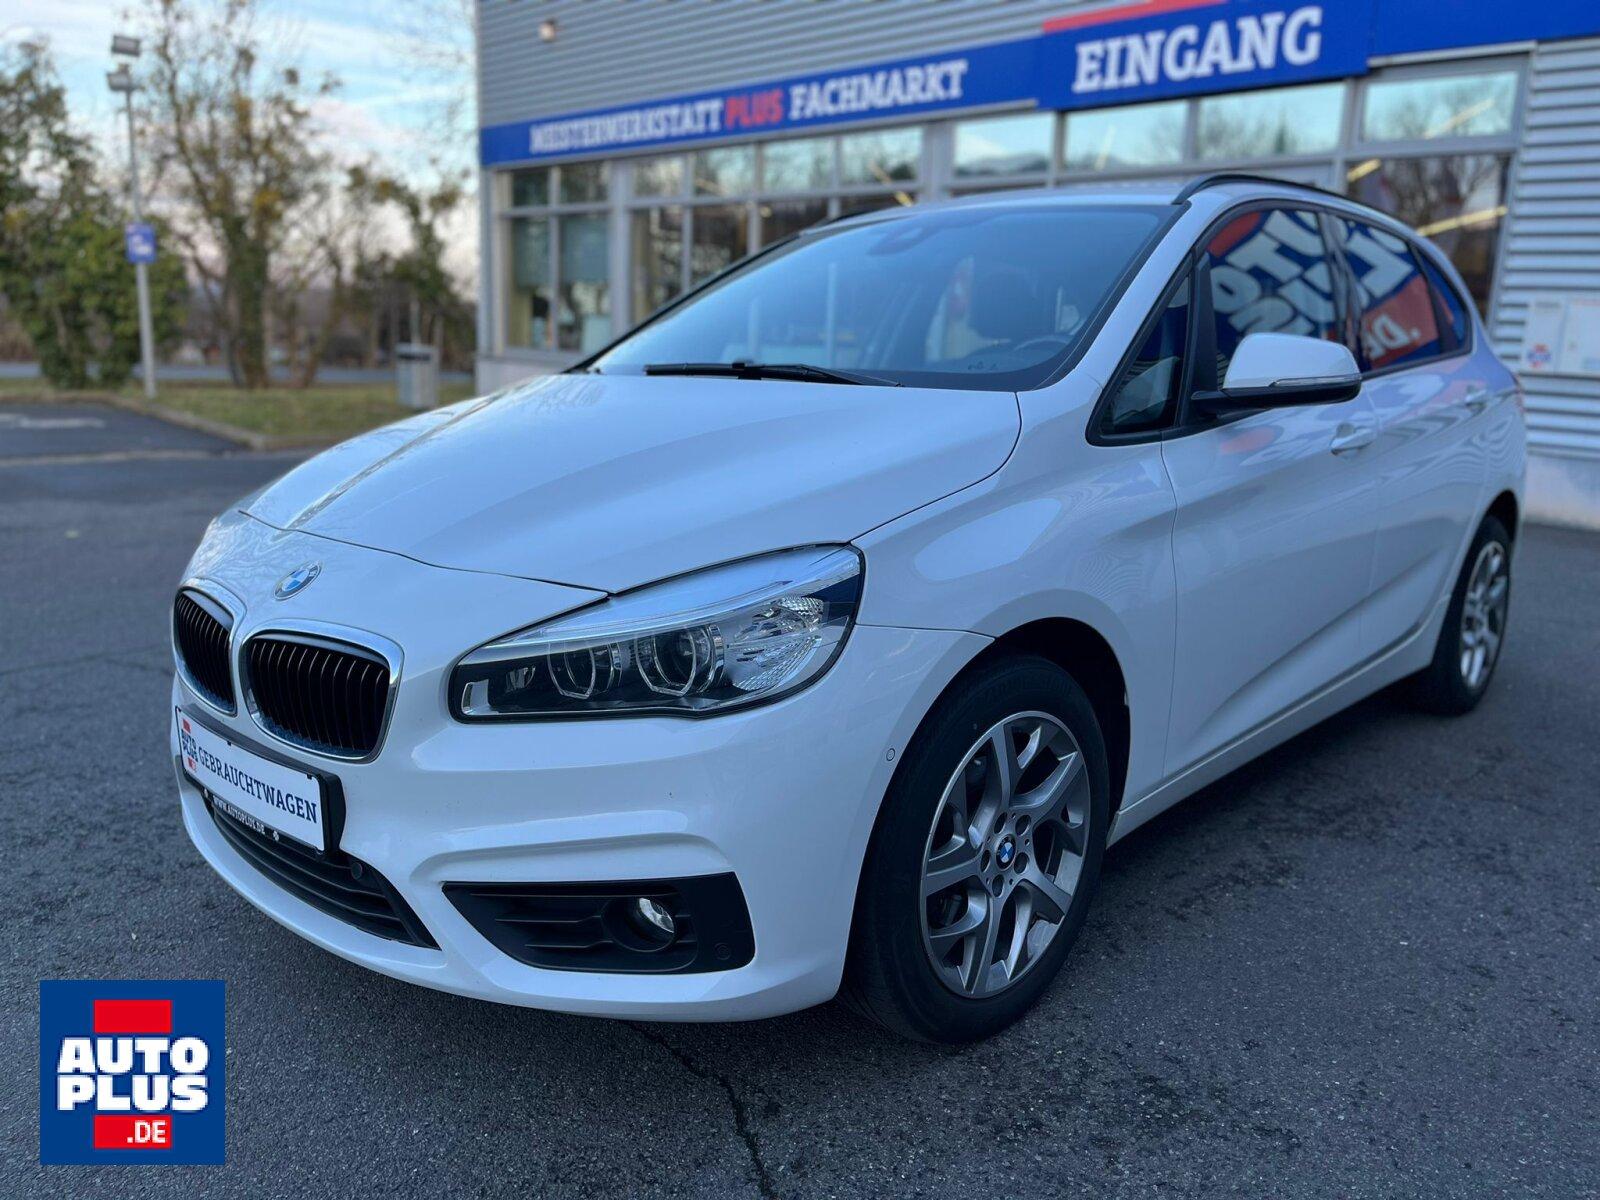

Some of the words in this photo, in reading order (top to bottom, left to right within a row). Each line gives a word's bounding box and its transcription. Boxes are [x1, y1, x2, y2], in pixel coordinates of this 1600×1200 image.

[1071, 6, 1323, 94] EINGANG
[725, 89, 783, 129] PLUS
[788, 58, 968, 121] FACHMARKT
[199, 746, 317, 824] GEBRAUCHTWAGEN
